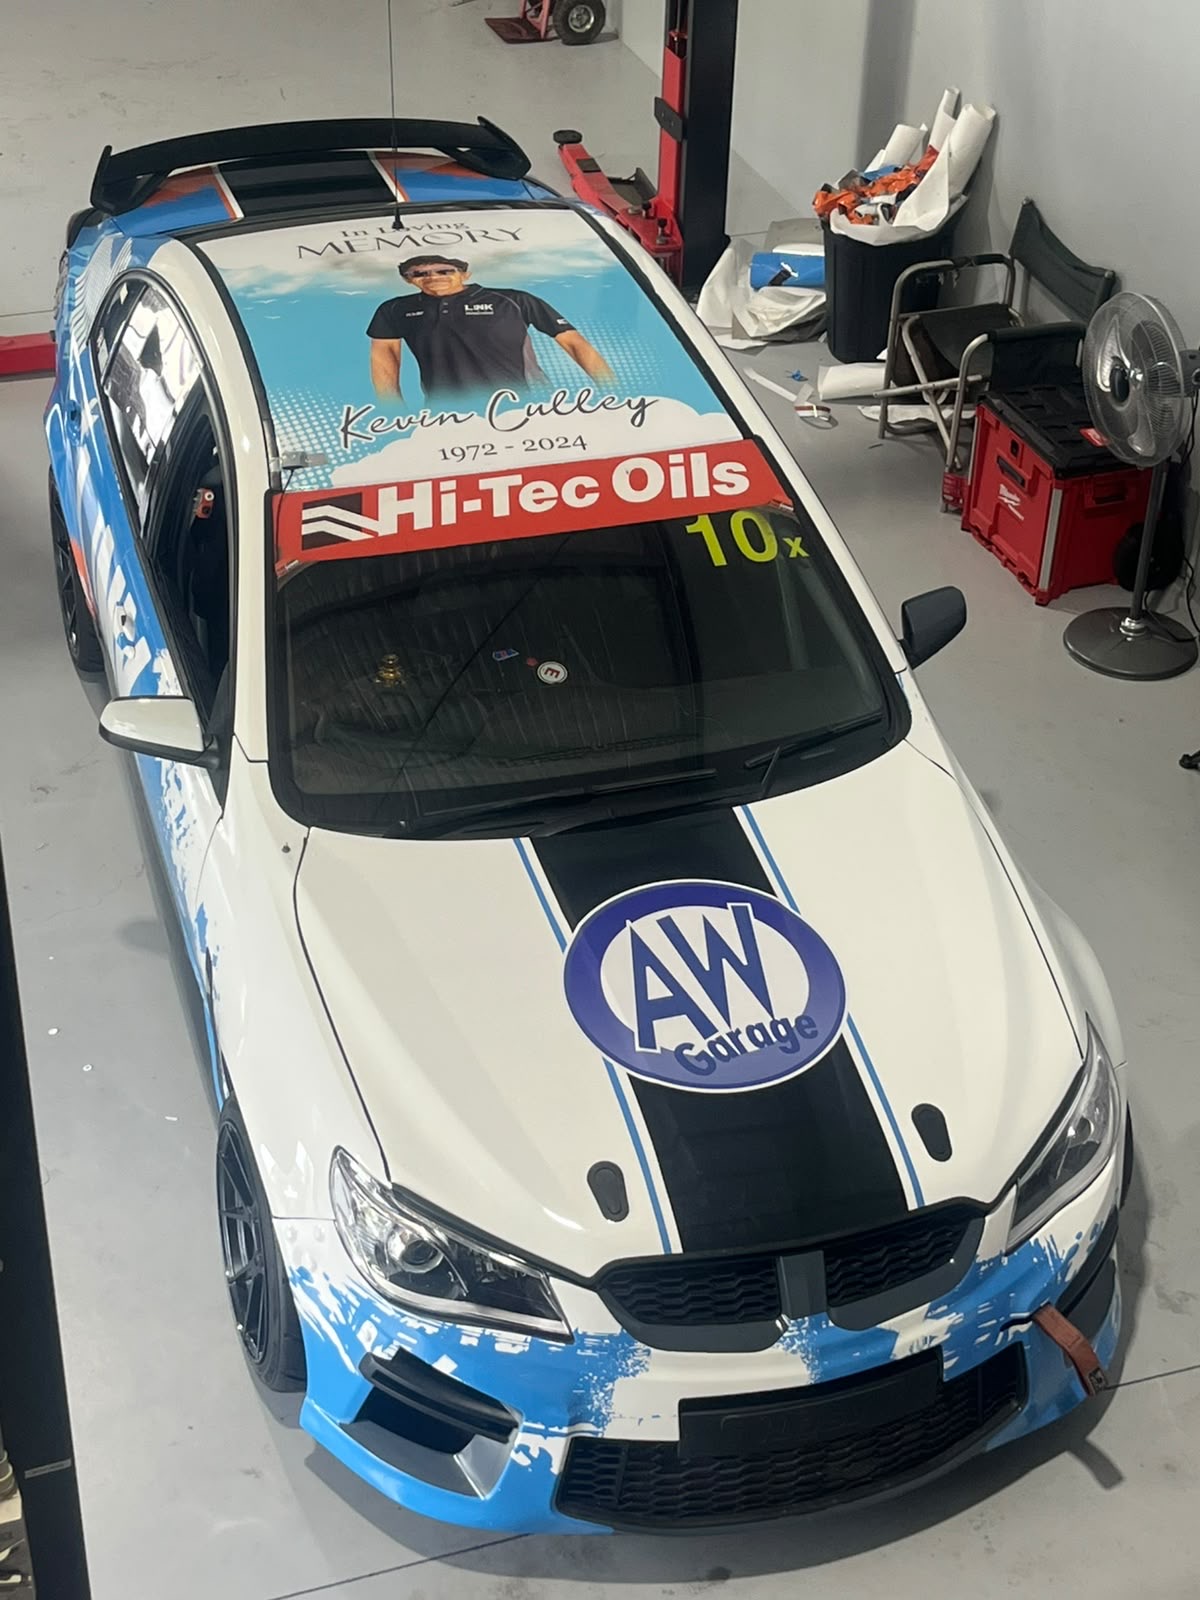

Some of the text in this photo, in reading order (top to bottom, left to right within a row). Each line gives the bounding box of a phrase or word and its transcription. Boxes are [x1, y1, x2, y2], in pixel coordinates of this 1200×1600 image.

[298, 227, 523, 259] MEMORY
[341, 230, 369, 238] In
[340, 387, 657, 449] Kevin Culley
[438, 442, 498, 463] 1972
[523, 434, 588, 453] 2024
[377, 452, 751, 537] Hi-Tec Oils
[628, 903, 775, 1051] AW
[674, 1013, 819, 1077] Garage
